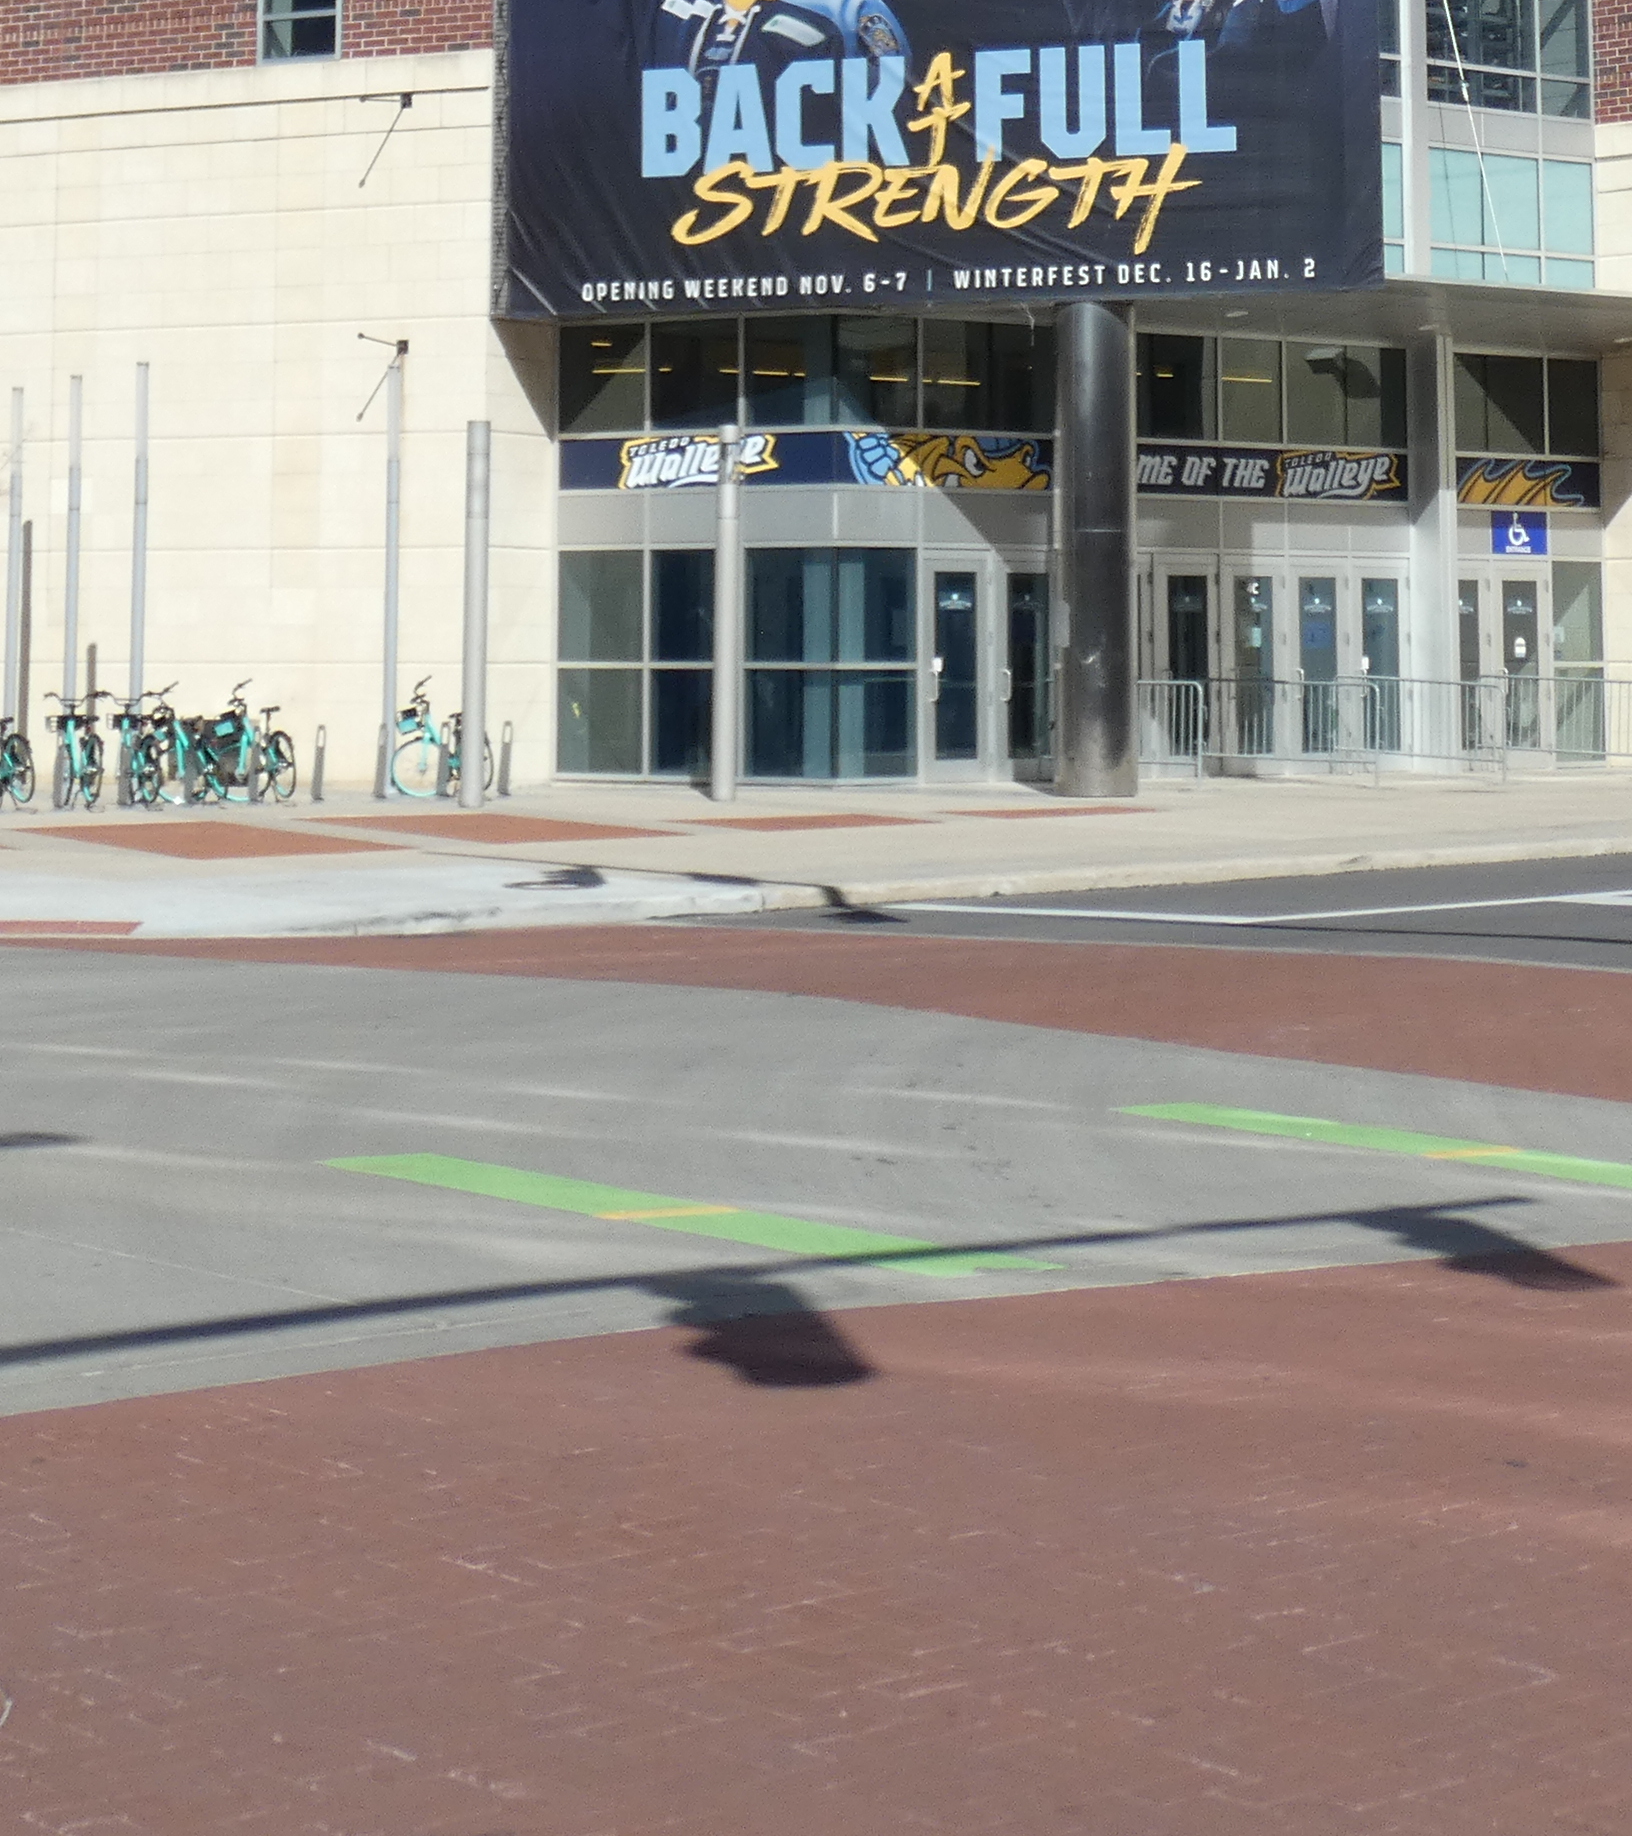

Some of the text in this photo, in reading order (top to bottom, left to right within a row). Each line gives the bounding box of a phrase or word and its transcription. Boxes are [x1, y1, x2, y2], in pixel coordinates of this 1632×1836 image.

[641, 40, 1237, 178] BACK AT FULL
[671, 143, 1202, 254] STRENGTH
[581, 279, 675, 302] OPENING
[684, 276, 789, 300] WEEKEND
[799, 274, 853, 295] NOV.
[863, 271, 908, 293] 6-7
[953, 264, 1107, 290] WINTERFEST
[1118, 262, 1173, 285] DEC.
[1304, 257, 1317, 279] 2
[625, 435, 766, 489] Wallee
[629, 436, 690, 457] TOLEDO
[1138, 454, 1269, 489] ME OF THE
[1282, 455, 1390, 499] Walleye
